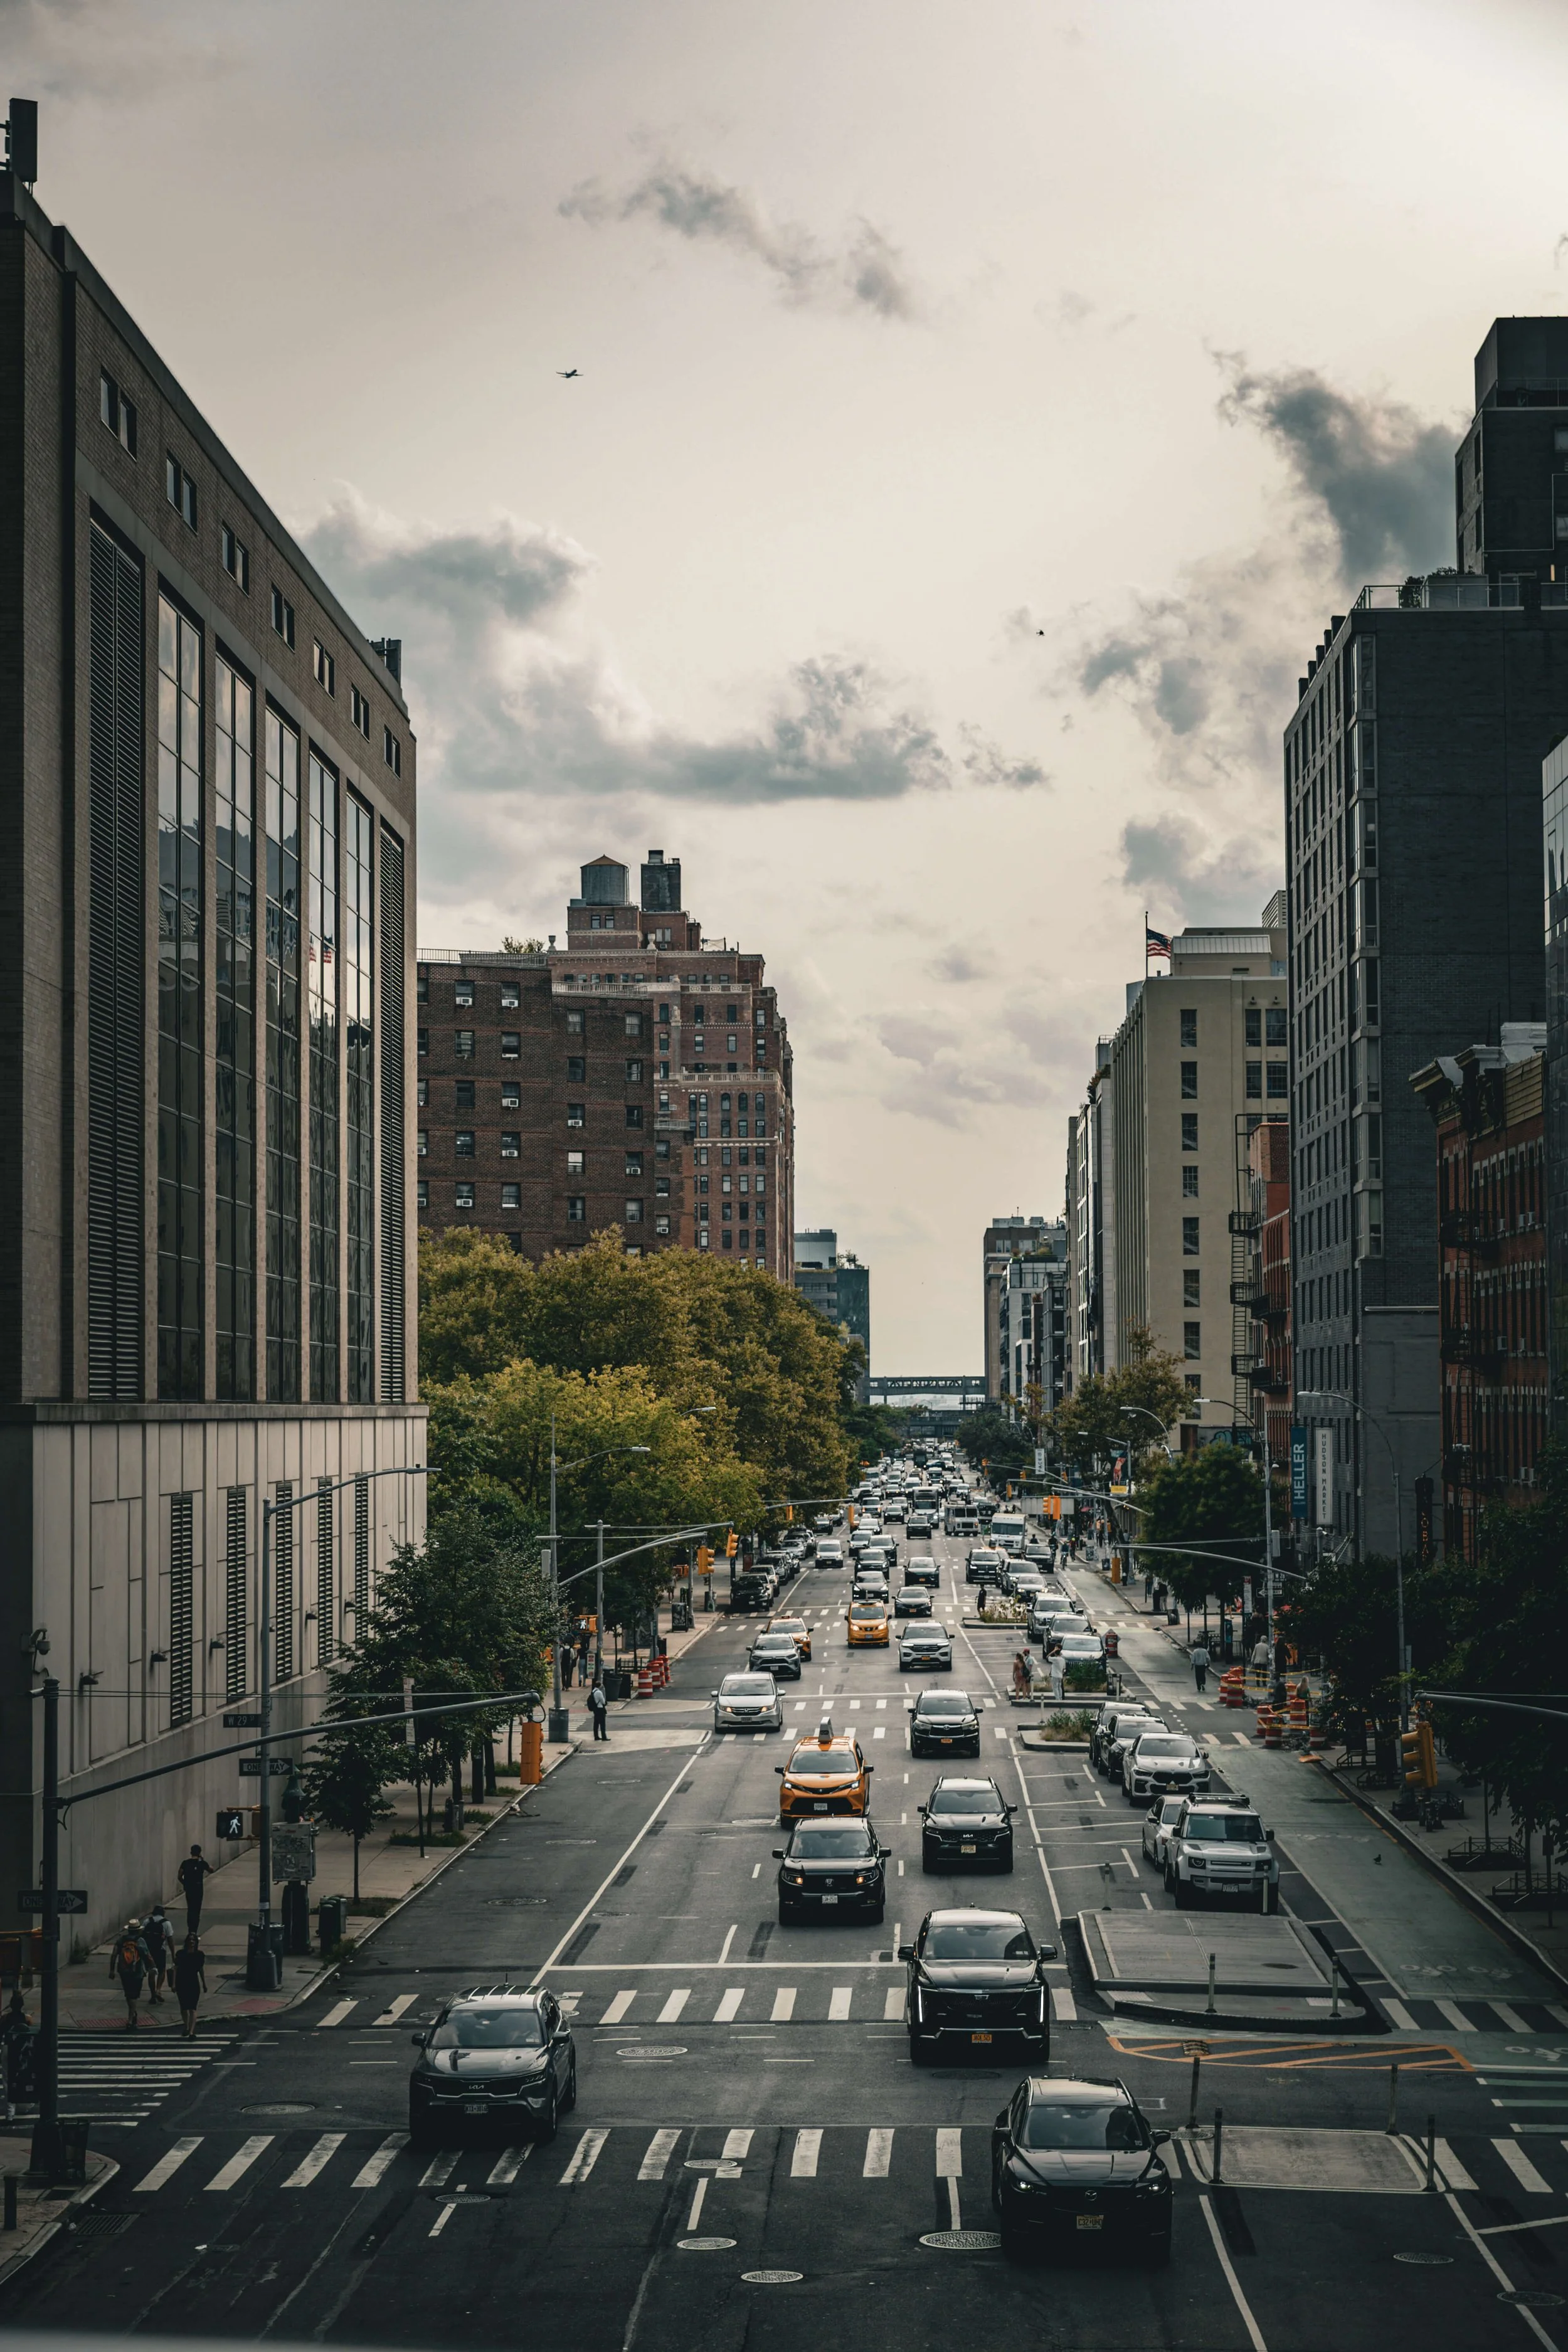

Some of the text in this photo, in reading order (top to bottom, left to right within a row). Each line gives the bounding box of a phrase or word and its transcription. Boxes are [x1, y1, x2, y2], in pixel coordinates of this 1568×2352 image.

[1293, 1444, 1305, 1500] HELLER
[228, 1716, 235, 1726] W
[238, 1716, 247, 1726] 29
[25, 1897, 75, 1907] ONE WAY
